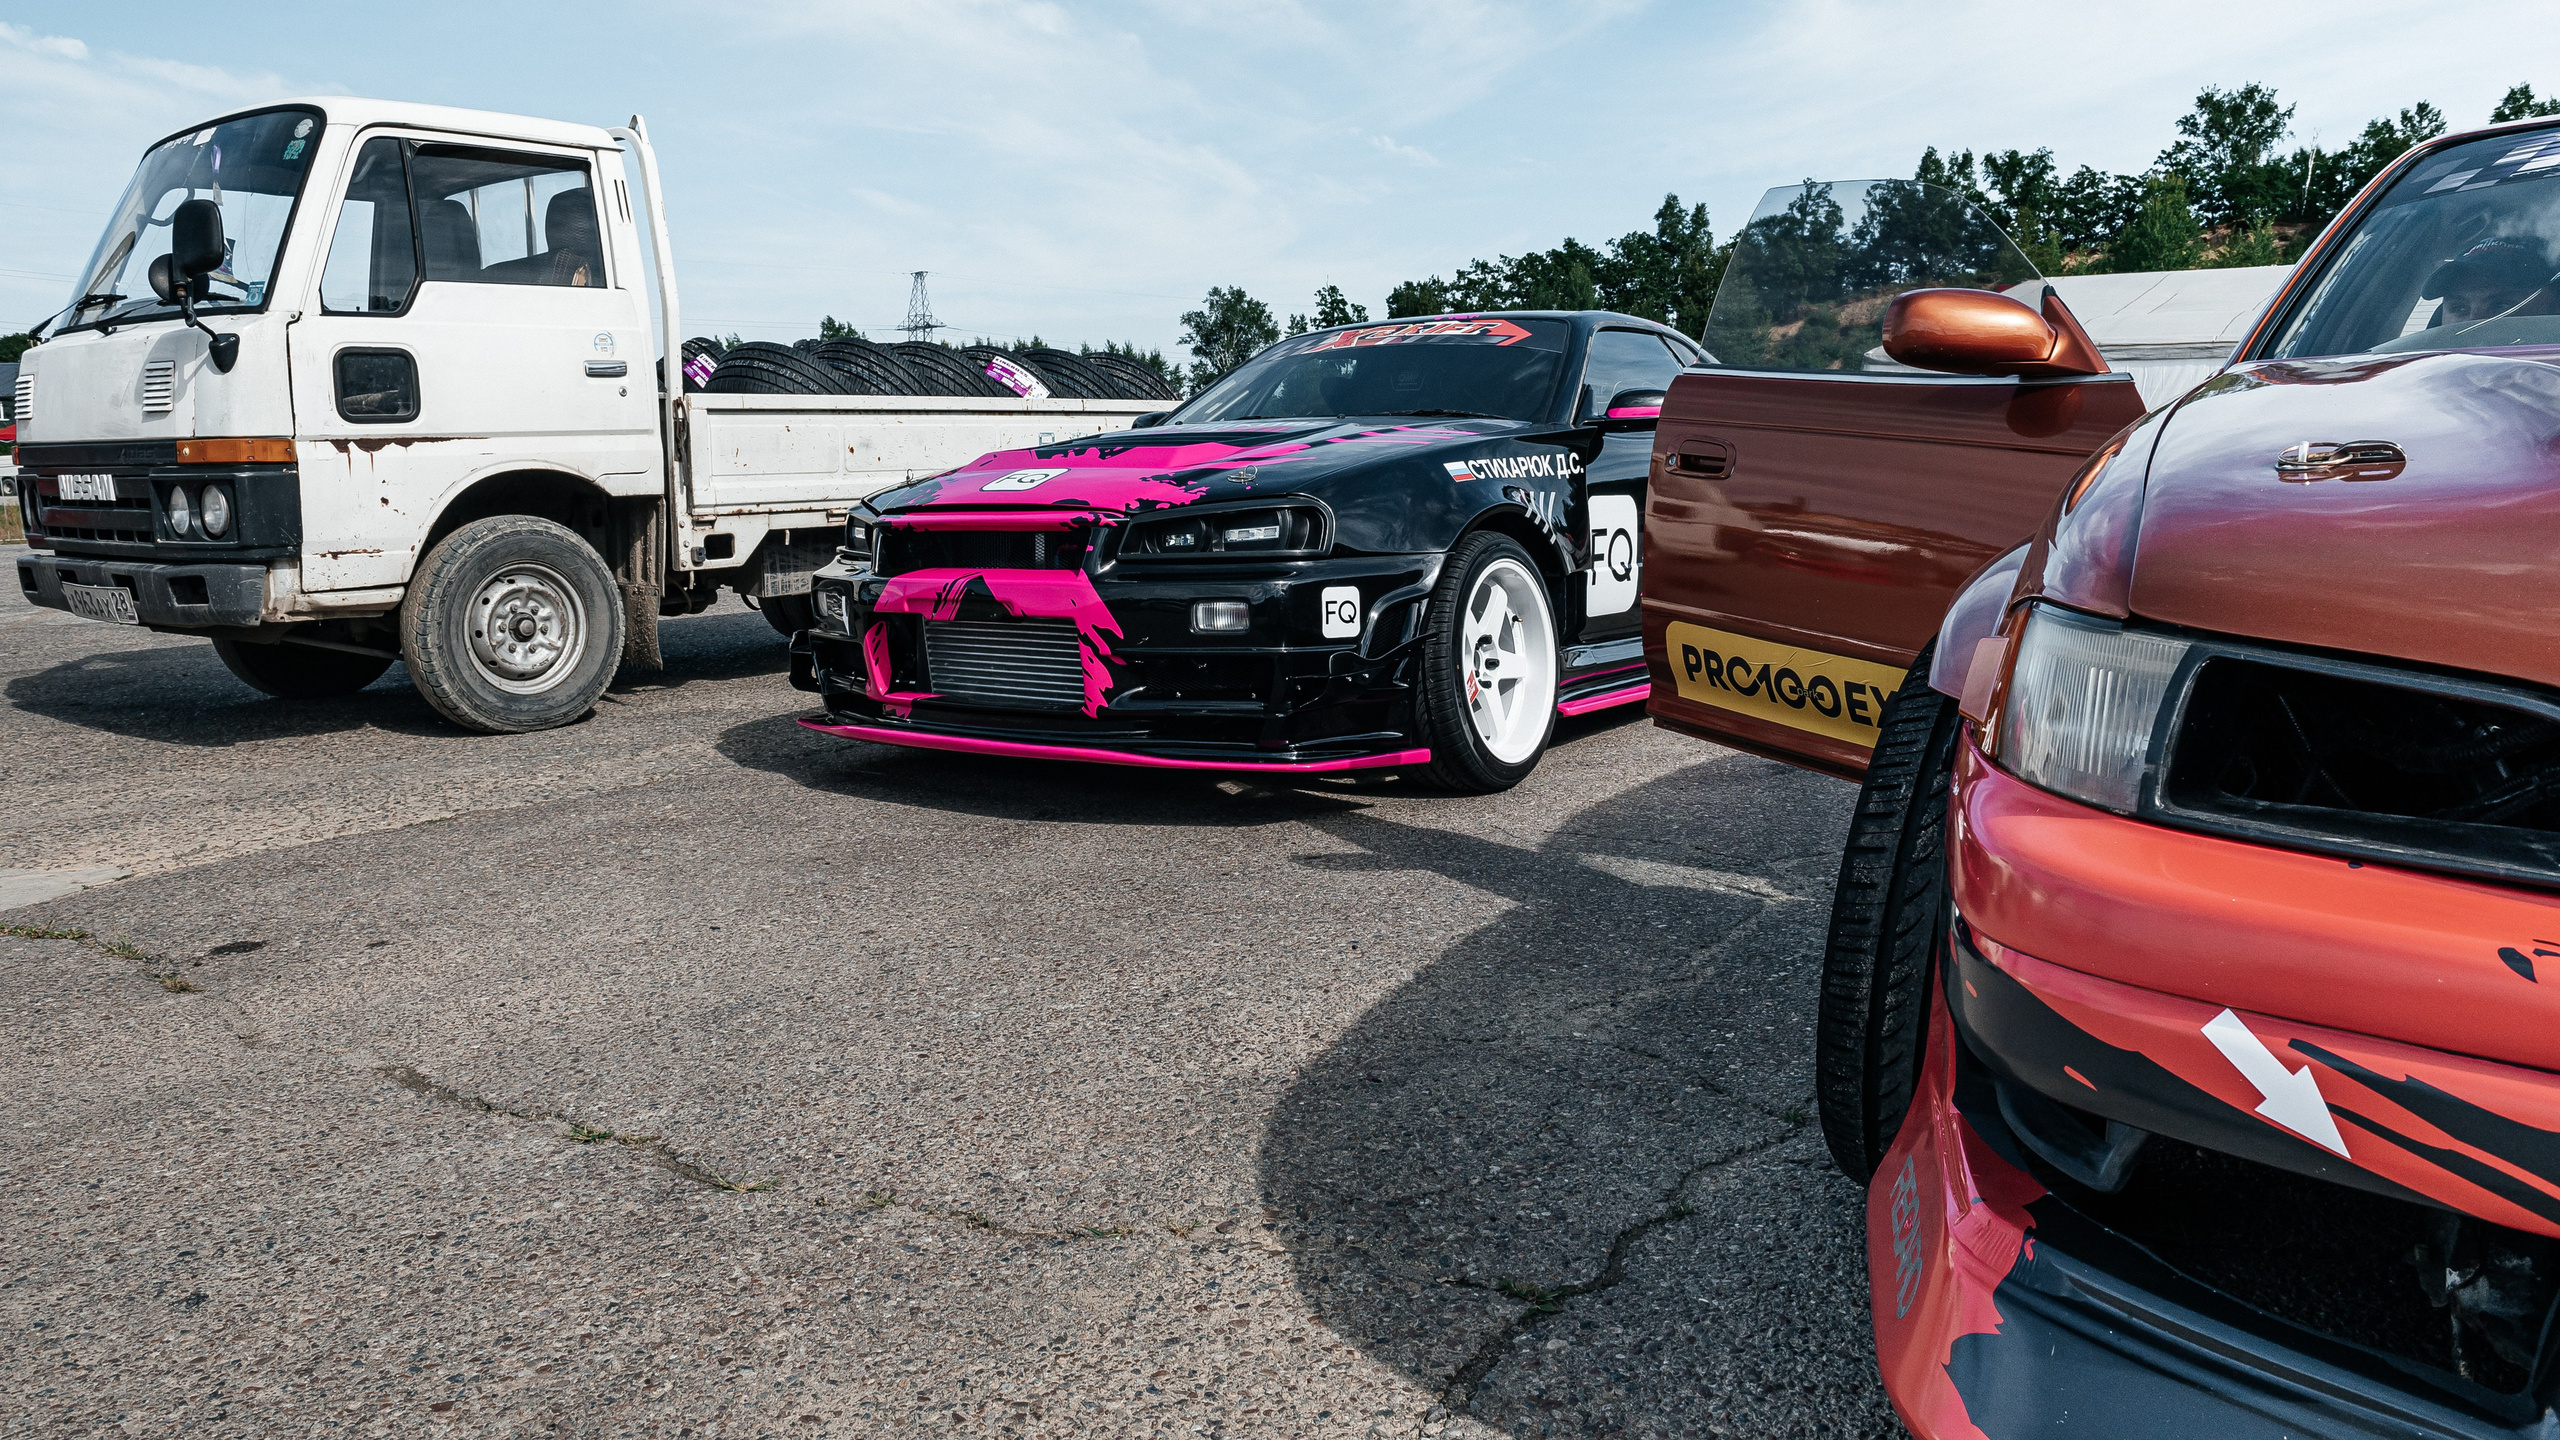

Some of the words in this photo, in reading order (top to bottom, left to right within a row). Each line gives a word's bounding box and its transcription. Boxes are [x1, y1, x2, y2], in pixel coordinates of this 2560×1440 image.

[1467, 455, 1555, 479] СТИХАРЮК
[1556, 452, 1584, 479] Д.С.
[58, 474, 116, 501] NISSAN
[995, 474, 1050, 484] FQ
[1591, 527, 1633, 586] FQ
[111, 592, 128, 612] 28
[1325, 600, 1357, 625] FQ
[1796, 687, 1819, 700] park
[1889, 1151, 1923, 1320] RECARO
